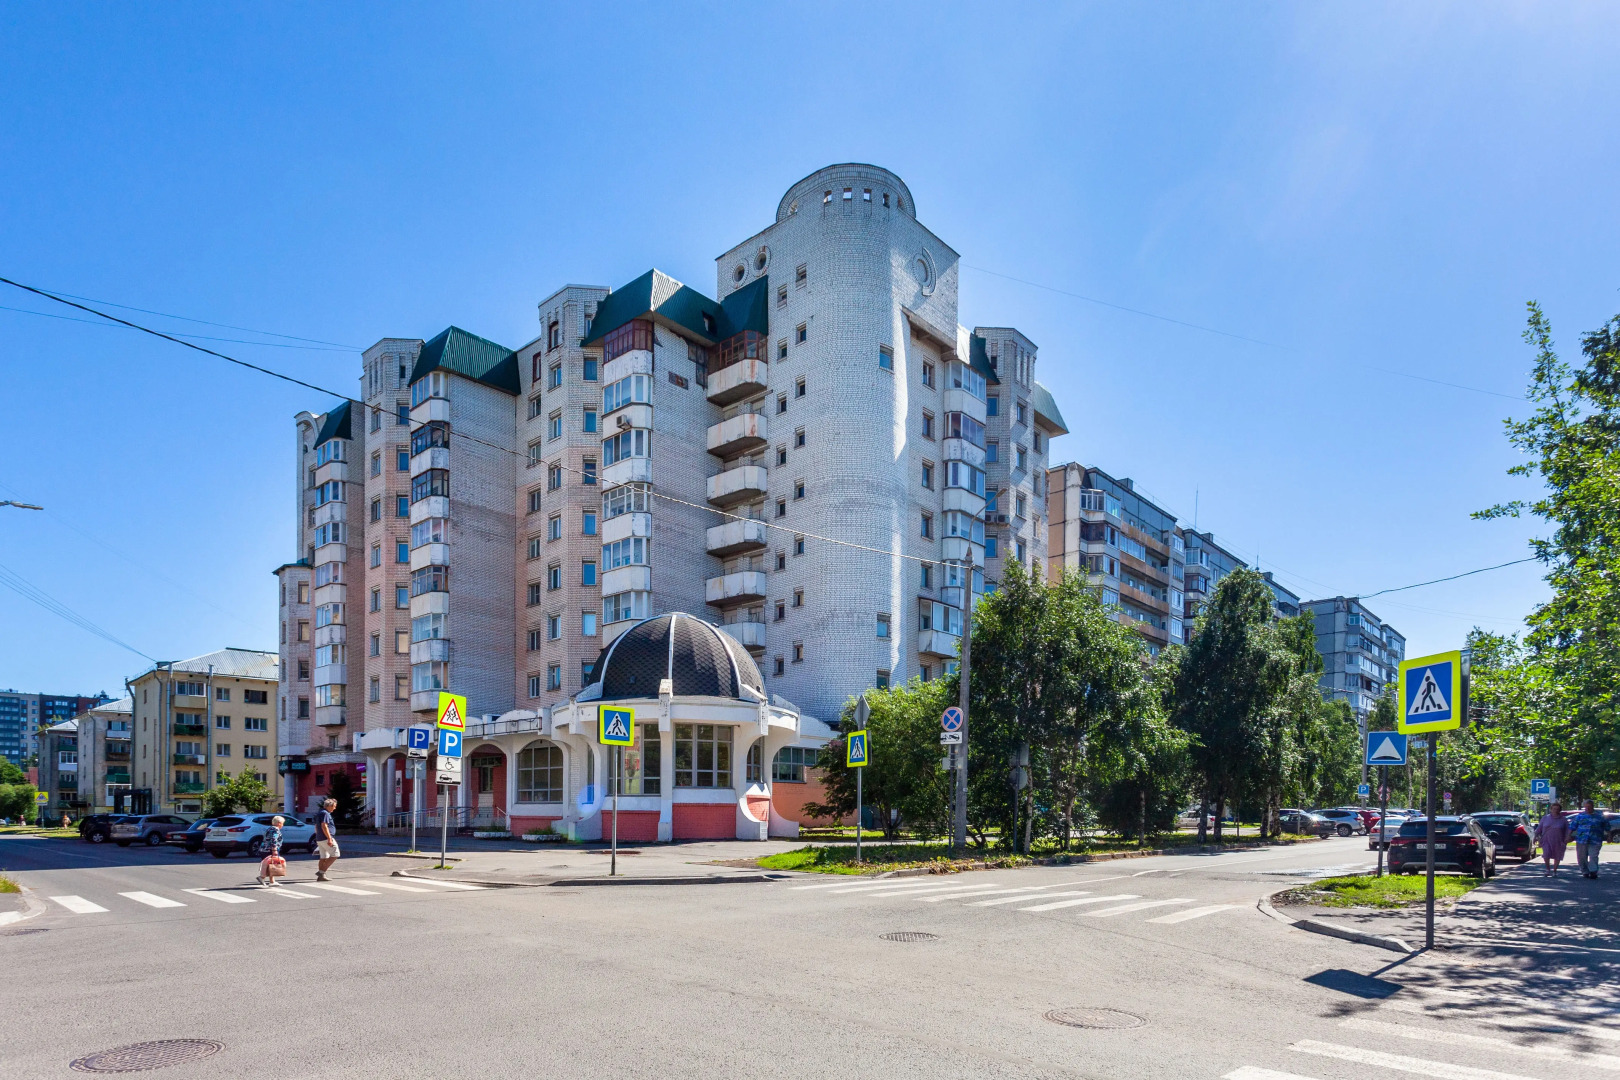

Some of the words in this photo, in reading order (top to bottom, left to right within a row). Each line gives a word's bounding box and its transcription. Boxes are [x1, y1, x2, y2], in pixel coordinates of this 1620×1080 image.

[414, 731, 426, 747] P
[445, 732, 459, 754] P
[1535, 781, 1545, 791] P
